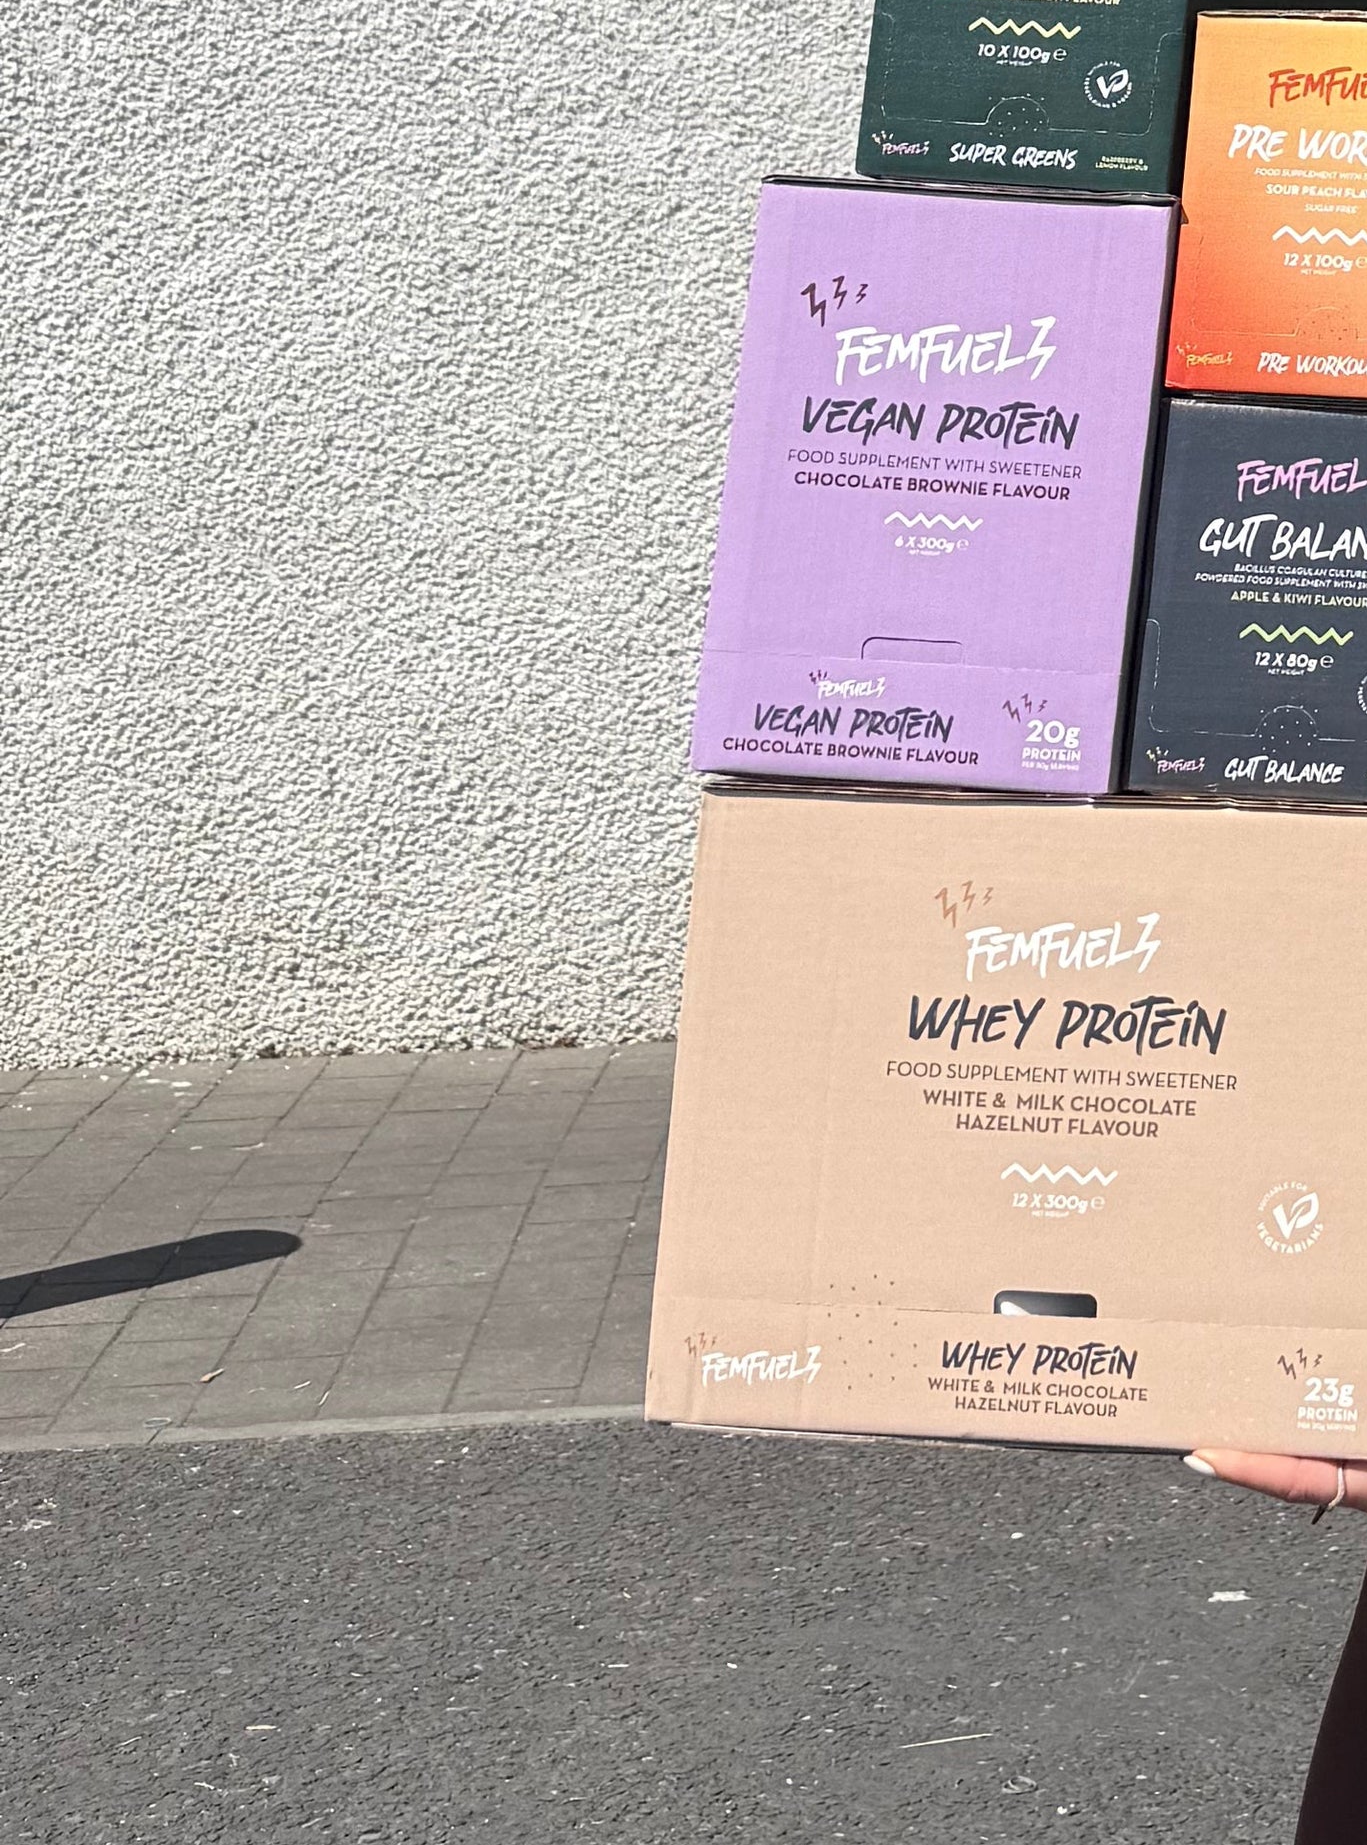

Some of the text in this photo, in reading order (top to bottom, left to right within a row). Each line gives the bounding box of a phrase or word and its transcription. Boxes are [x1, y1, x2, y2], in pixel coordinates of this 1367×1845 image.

[977, 43, 996, 57] 10
[998, 44, 1010, 57] X
[1012, 45, 1051, 64] 100g
[1228, 123, 1289, 162] PRE
[949, 142, 1078, 170] SUPER GREENS
[1254, 167, 1281, 177] FOOD
[1265, 183, 1300, 196] SOUR
[1301, 185, 1343, 198] PEACH
[1304, 203, 1358, 214] SUGAR FREE
[1284, 253, 1299, 267] 12
[1301, 253, 1313, 267] X
[1315, 254, 1354, 273] 100g
[1256, 352, 1289, 373] PRE
[802, 396, 926, 446] VEGAN
[787, 448, 1082, 479] FOOD SUPPLEMENT WITH SWEETENER
[794, 471, 1070, 501] CHOCOLATE BROWNIE FLAVOUR
[894, 536, 904, 547] 6
[917, 536, 955, 553] 300g
[1199, 513, 1278, 558] GUT
[1247, 575, 1273, 585] FOOD
[1274, 577, 1331, 588] SUPPLEMENT
[1230, 590, 1269, 602] APPLE
[1272, 593, 1281, 603] &
[1284, 593, 1312, 604] KIWI
[1255, 651, 1271, 666] 12
[1272, 653, 1285, 666] X
[1286, 654, 1318, 672] 80g
[754, 703, 842, 738] VEGAN
[1025, 719, 1081, 749] 20g
[722, 737, 979, 766] CHOCOLATE BROWNIE FLAVOUR
[1022, 747, 1081, 762] PROTEIN
[1224, 755, 1345, 784] GUT BALANCE
[909, 994, 1046, 1051] WHEY
[886, 1060, 1237, 1091] FOOD SUPPLEMENT WITH SWEETENER
[923, 1089, 1197, 1117] WHITE & MILK CHOCOLATE
[956, 1114, 1159, 1138] HAZELNUT FLAVOUR
[1012, 1192, 1028, 1207] 12
[1030, 1193, 1042, 1208] X
[1044, 1194, 1088, 1214] 300g
[1256, 1220, 1324, 1254] VEGETARIANS
[941, 1339, 1026, 1376] WHEY
[928, 1377, 1148, 1402] WHITE & MILK CHOCOLATE
[1303, 1376, 1355, 1408] 23g
[955, 1395, 1118, 1417] HAZELNUT FLAVOUR
[1297, 1406, 1358, 1422] PROTEIN
